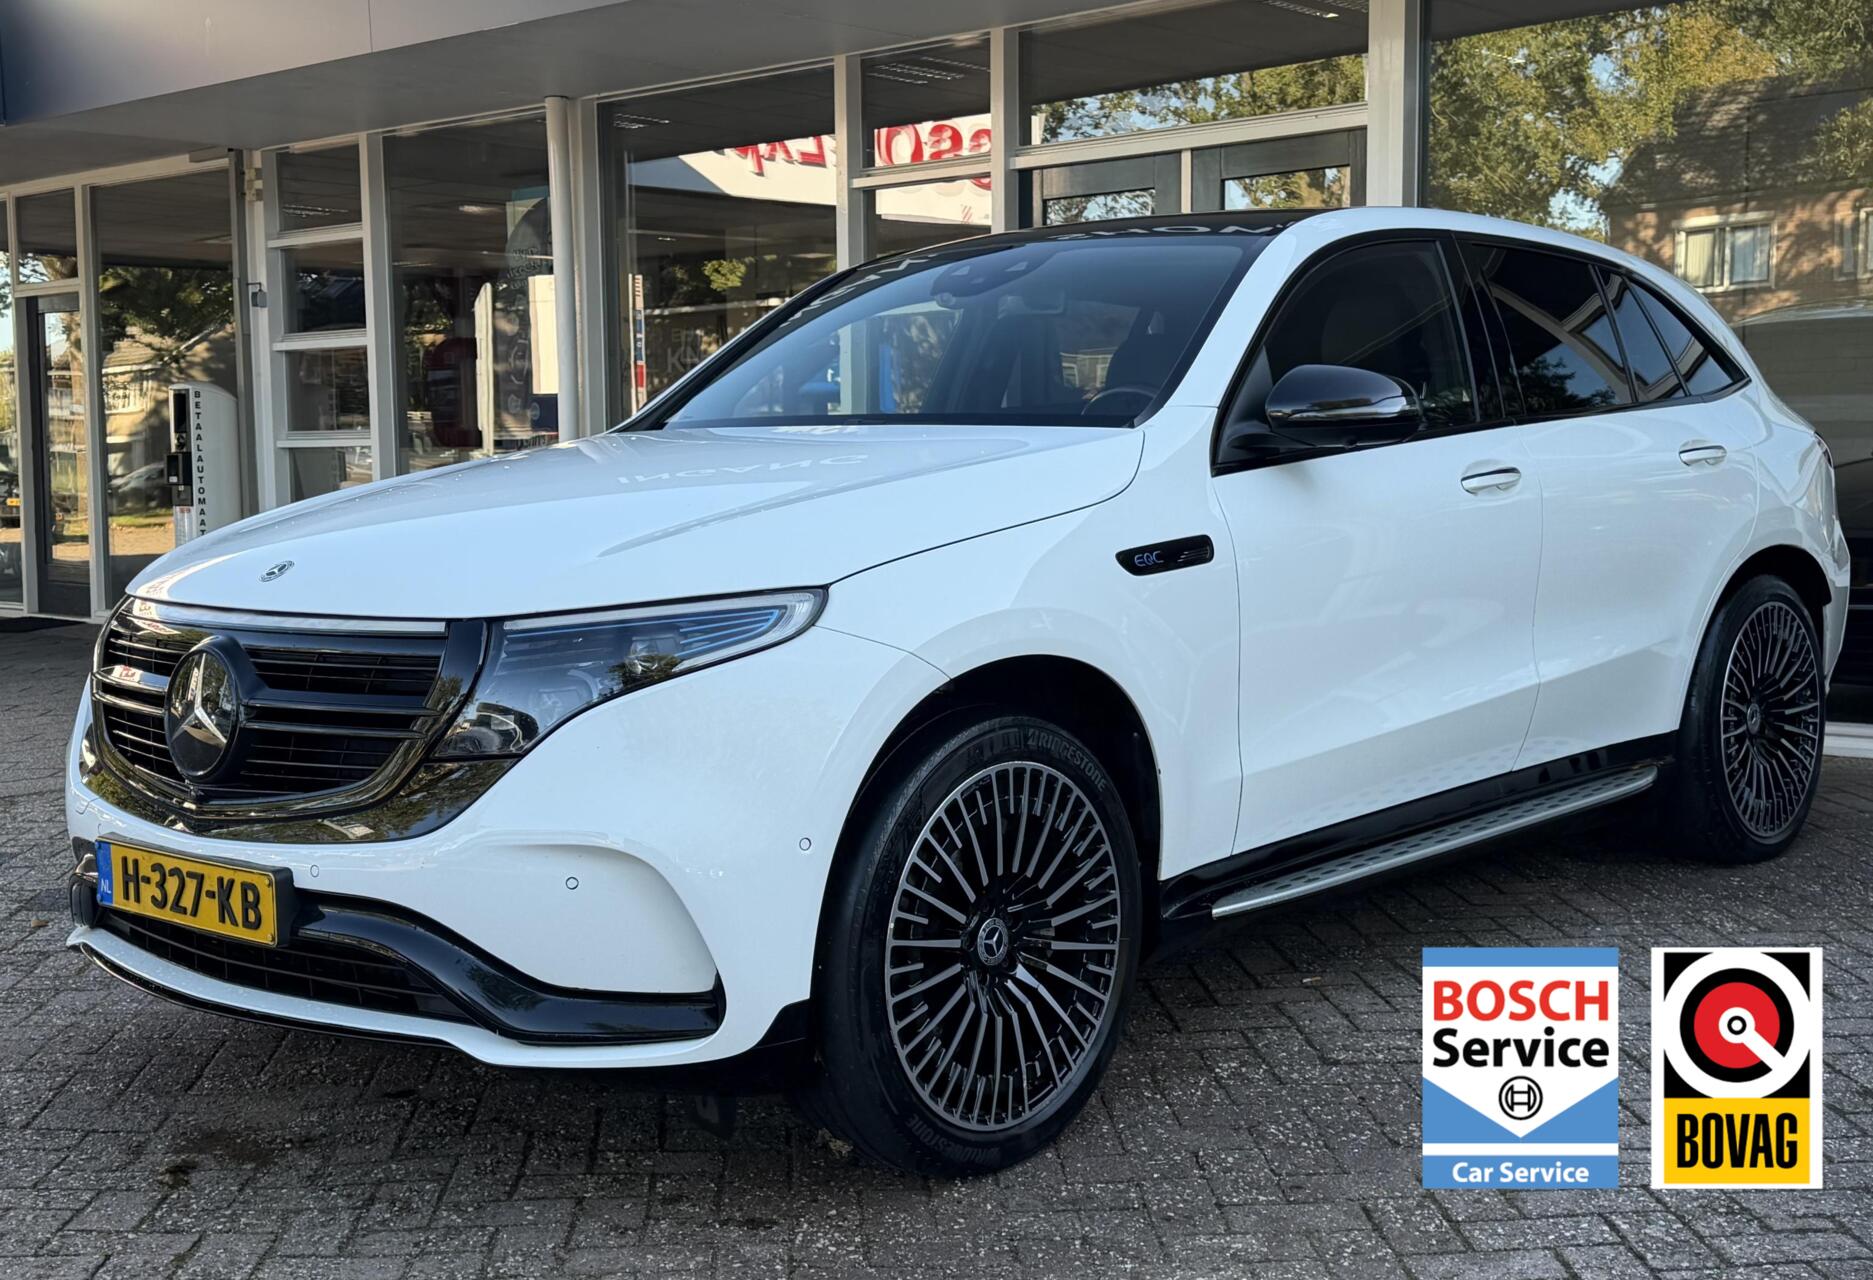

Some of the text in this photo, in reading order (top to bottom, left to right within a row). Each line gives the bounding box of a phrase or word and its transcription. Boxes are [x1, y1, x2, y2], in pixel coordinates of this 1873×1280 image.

[194, 391, 206, 535] BETAALAUTOMAAT
[1134, 550, 1165, 567] EQC
[100, 855, 263, 930] NL H-327-KB
